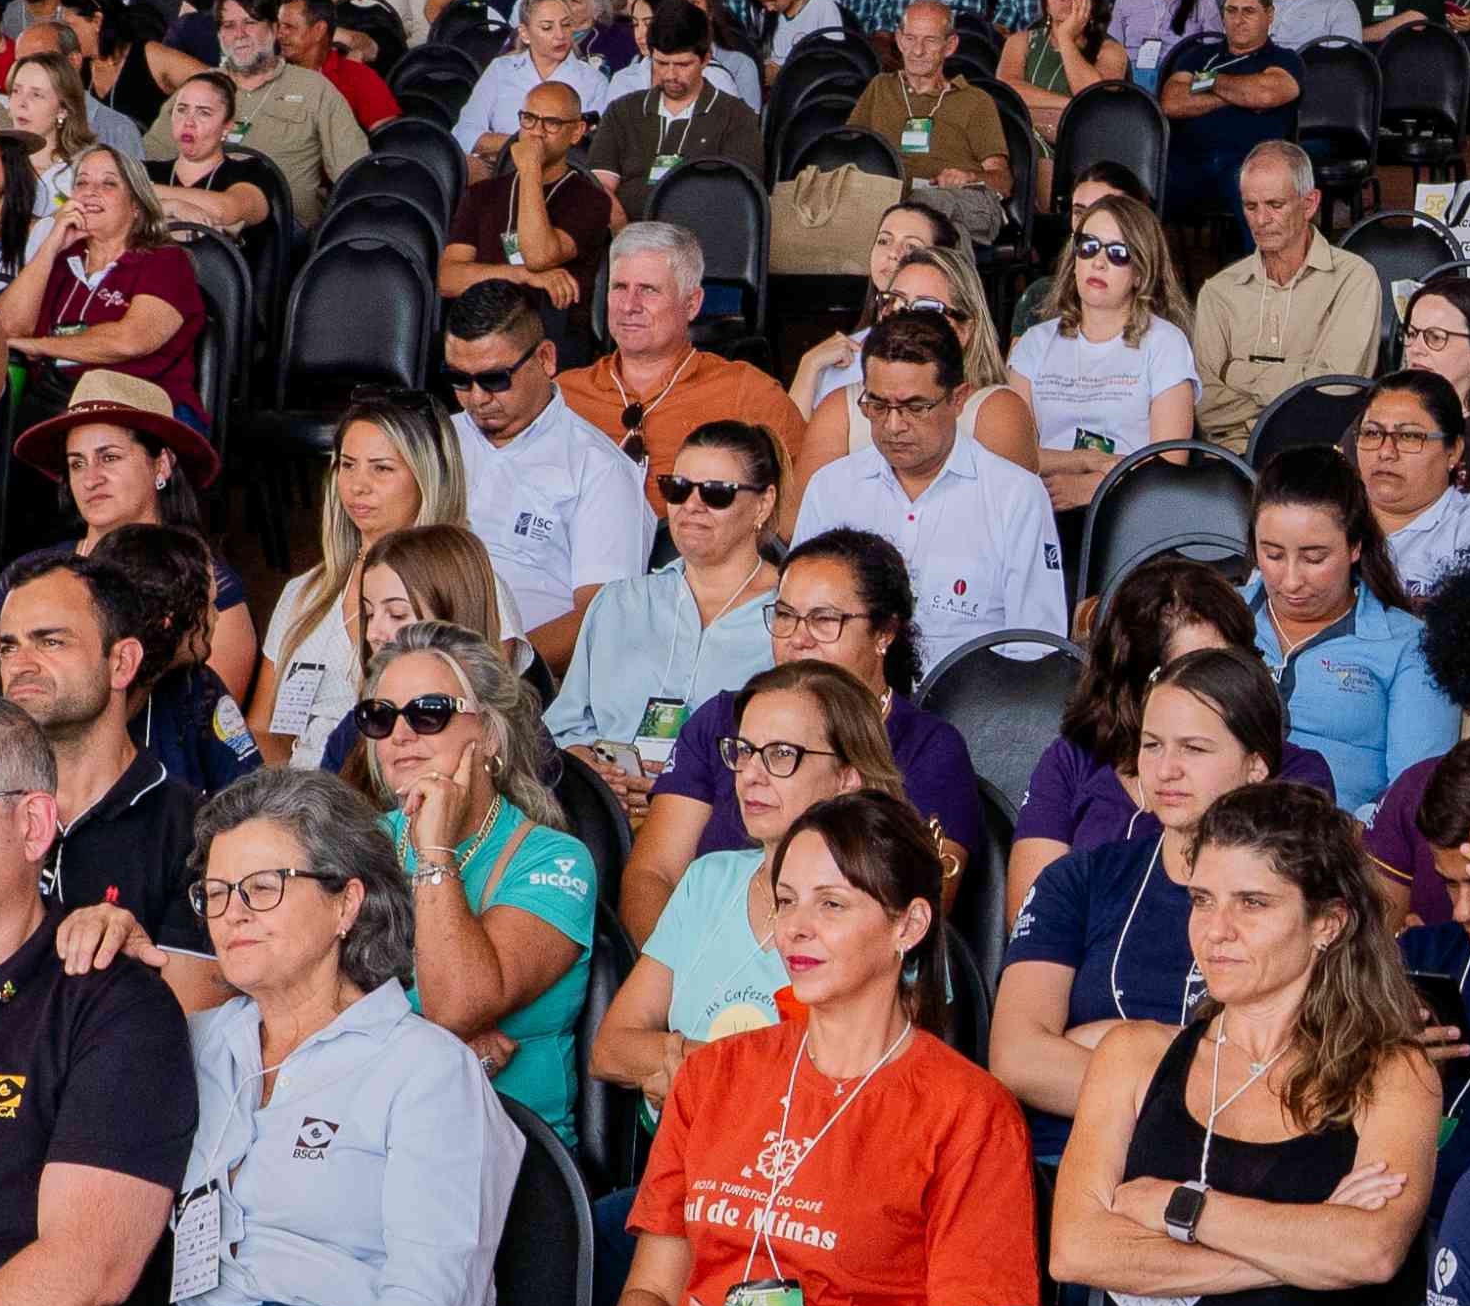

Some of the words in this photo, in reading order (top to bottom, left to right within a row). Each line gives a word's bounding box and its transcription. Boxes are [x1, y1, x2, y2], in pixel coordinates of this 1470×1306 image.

[533, 516, 554, 531] ISC
[292, 1149, 325, 1161] BSCA
[794, 1196, 823, 1212] CAFÉ
[706, 1199, 738, 1226] de
[746, 1209, 838, 1251] Minas
